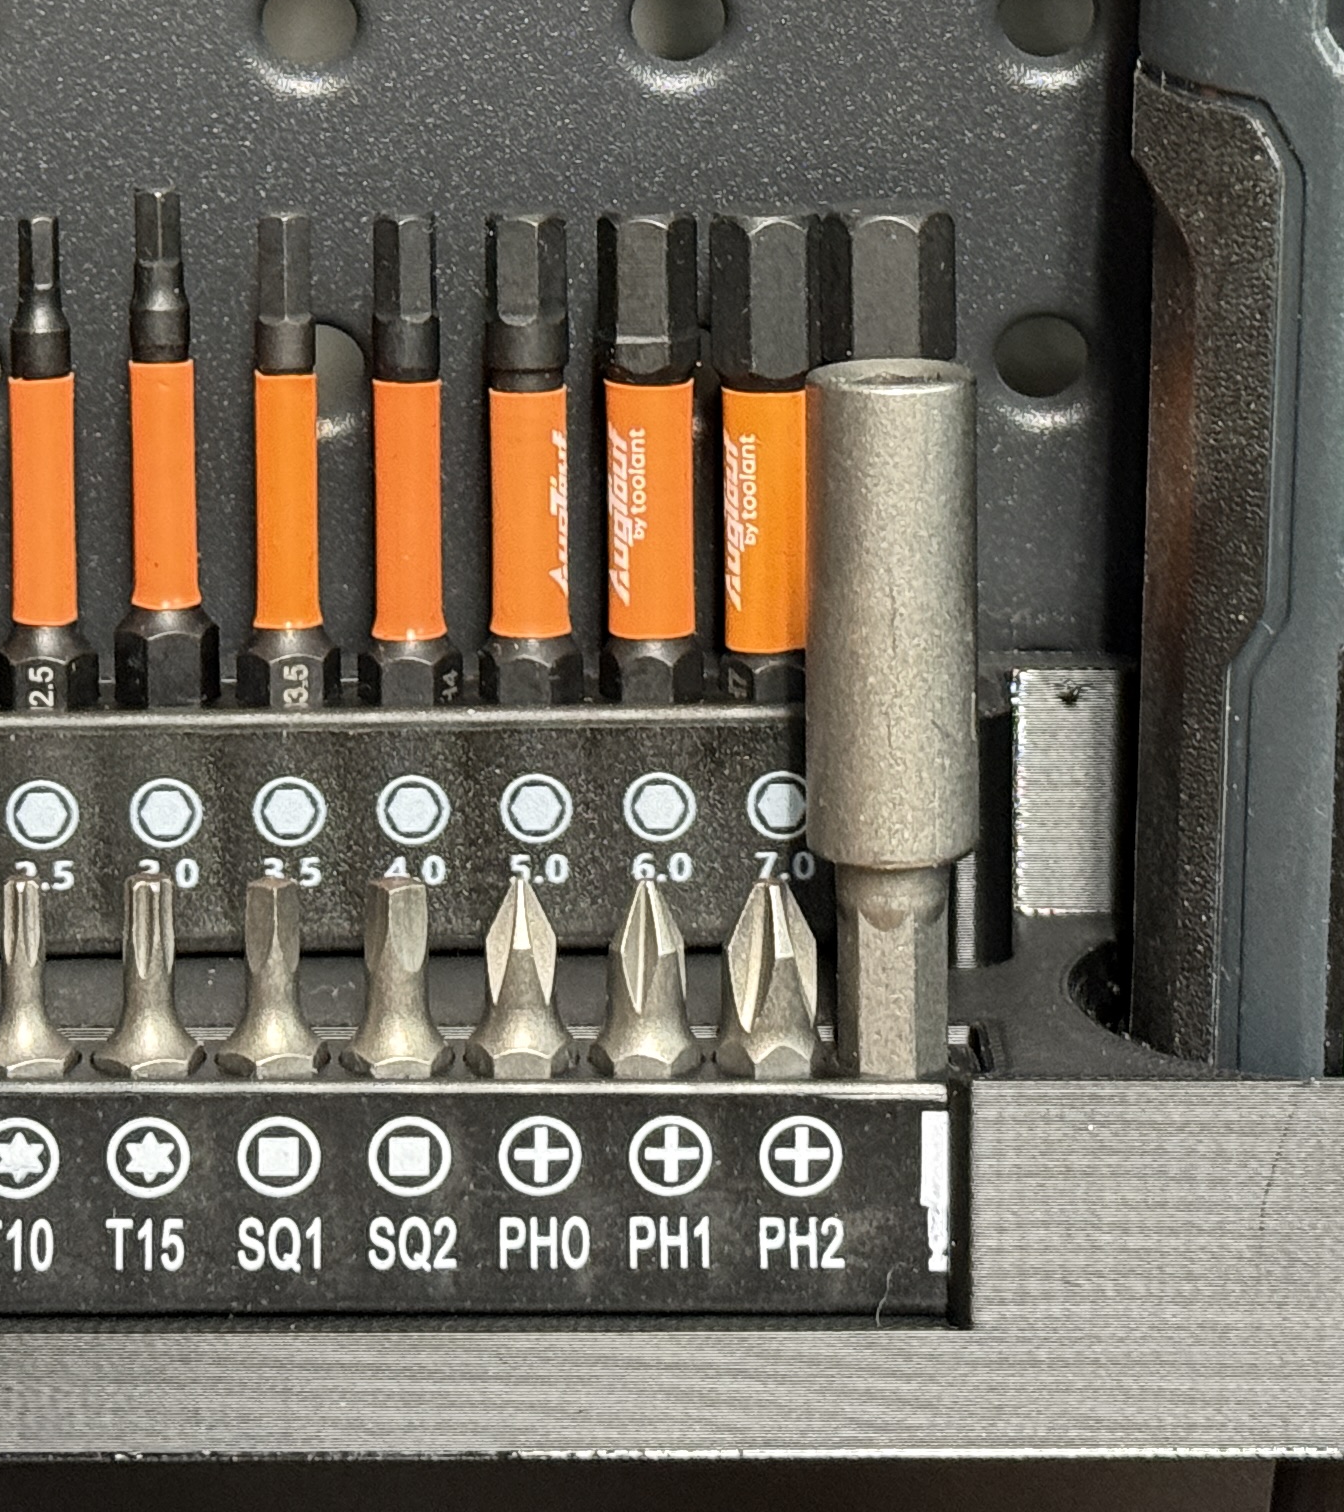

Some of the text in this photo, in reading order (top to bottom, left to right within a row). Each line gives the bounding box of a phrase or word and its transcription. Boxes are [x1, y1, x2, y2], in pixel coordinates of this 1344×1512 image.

[628, 427, 648, 540] by toolant
[739, 433, 759, 546] by toolant
[28, 666, 54, 710] 2.5
[283, 664, 309, 708] 3.5
[510, 854, 570, 884] 5.0
[632, 852, 693, 882] 6.0
[755, 851, 816, 881] 7.0
[106, 1217, 185, 1271] T15
[237, 1217, 322, 1272] SQ1
[368, 1216, 457, 1272] SQ2
[499, 1216, 590, 1270] PH0
[629, 1216, 710, 1269] PH1
[759, 1216, 845, 1269] PH2
